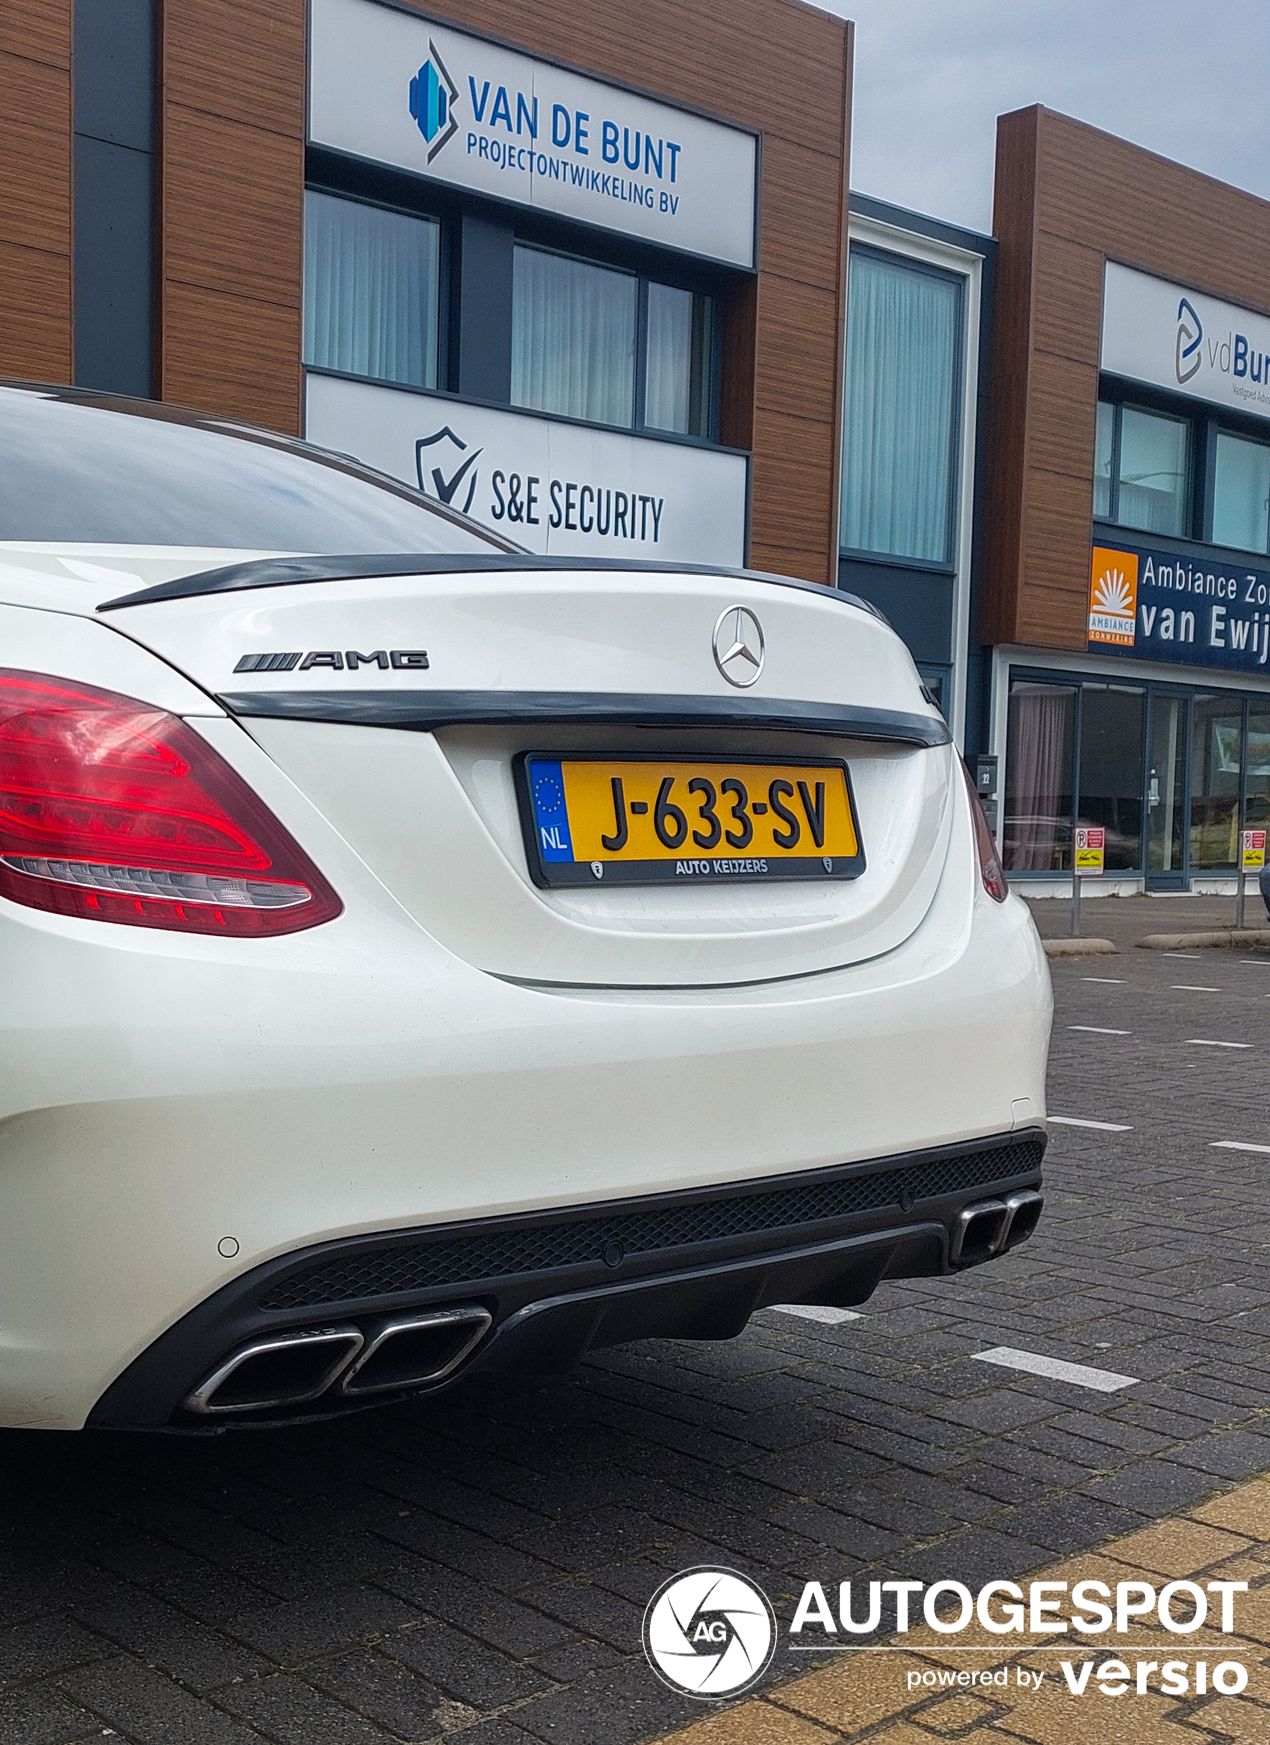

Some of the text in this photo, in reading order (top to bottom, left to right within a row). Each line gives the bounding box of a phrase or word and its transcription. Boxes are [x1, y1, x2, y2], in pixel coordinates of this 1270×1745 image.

[468, 75, 681, 183] VAN DE BUNT
[467, 132, 680, 215] PROJECTONTWIKKELING BV
[491, 470, 664, 543] S&E SECURITY
[1142, 556, 1270, 605] Ambiance Zo
[1090, 631, 1133, 645] ZONWERING
[1091, 616, 1134, 632] AMBIANCE
[1141, 605, 1195, 643] van
[299, 650, 430, 670] AMG
[602, 777, 825, 851] J-633-SV
[541, 827, 568, 850] NL
[675, 859, 768, 875] AUTO KEIJZERS
